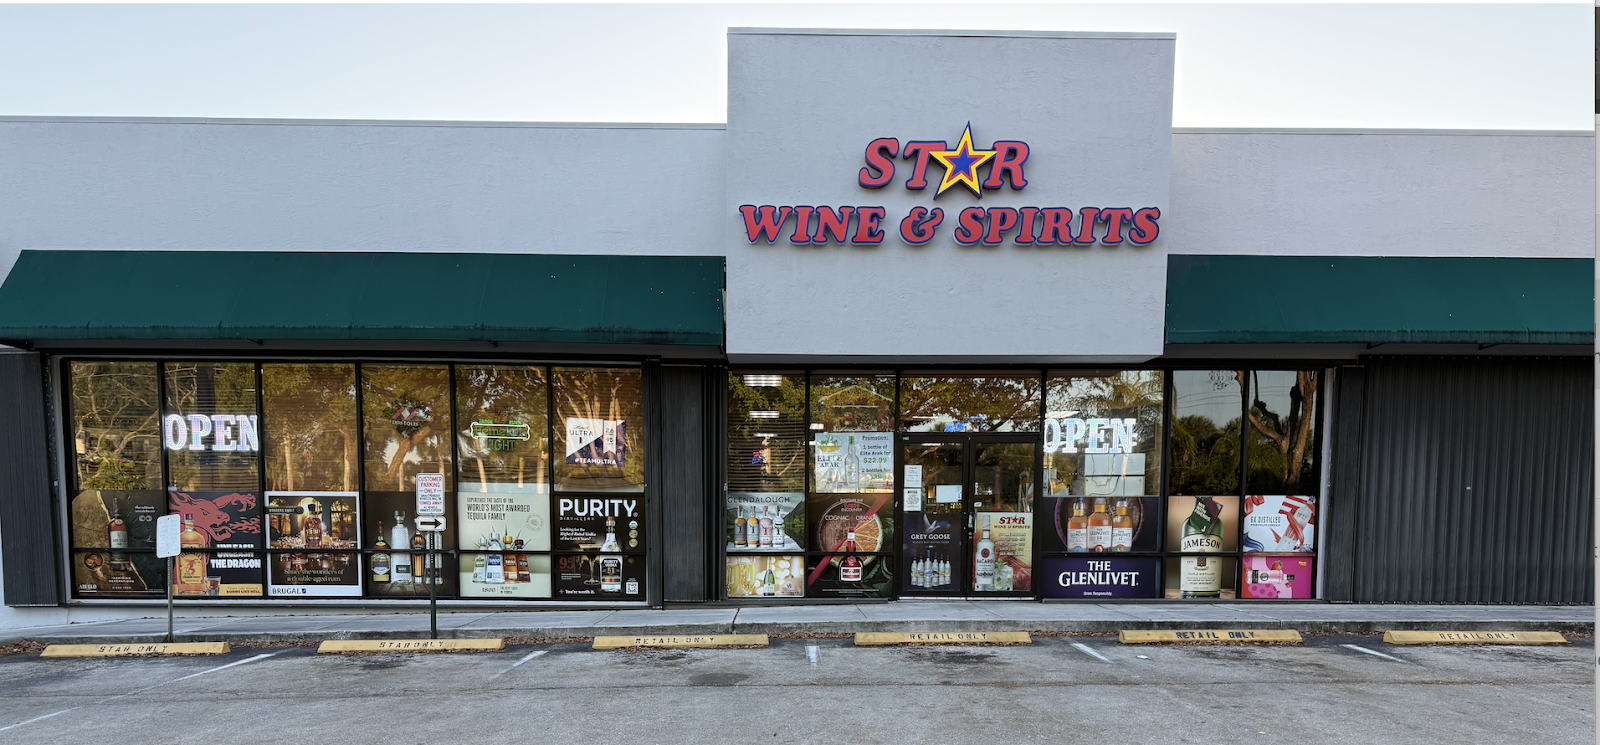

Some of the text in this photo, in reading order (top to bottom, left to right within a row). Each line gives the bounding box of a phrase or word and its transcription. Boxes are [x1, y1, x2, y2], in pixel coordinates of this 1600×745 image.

[738, 204, 1161, 247] WINE & SPIRITS
[163, 414, 259, 451] OPEN
[1043, 418, 1137, 453] OPEN
[574, 457, 617, 465] #TEAMULTRA
[467, 504, 531, 513] WORLD'S MOST AWARDED
[559, 498, 637, 517] PURITY
[467, 512, 506, 520] TEQUILA FAMILY
[1183, 538, 1220, 550] JAMESON
[210, 559, 261, 569] THE DRAGON
[559, 557, 576, 569] 95
[1087, 561, 1111, 571] THE
[1175, 631, 1255, 639] RETAIL ONLY
